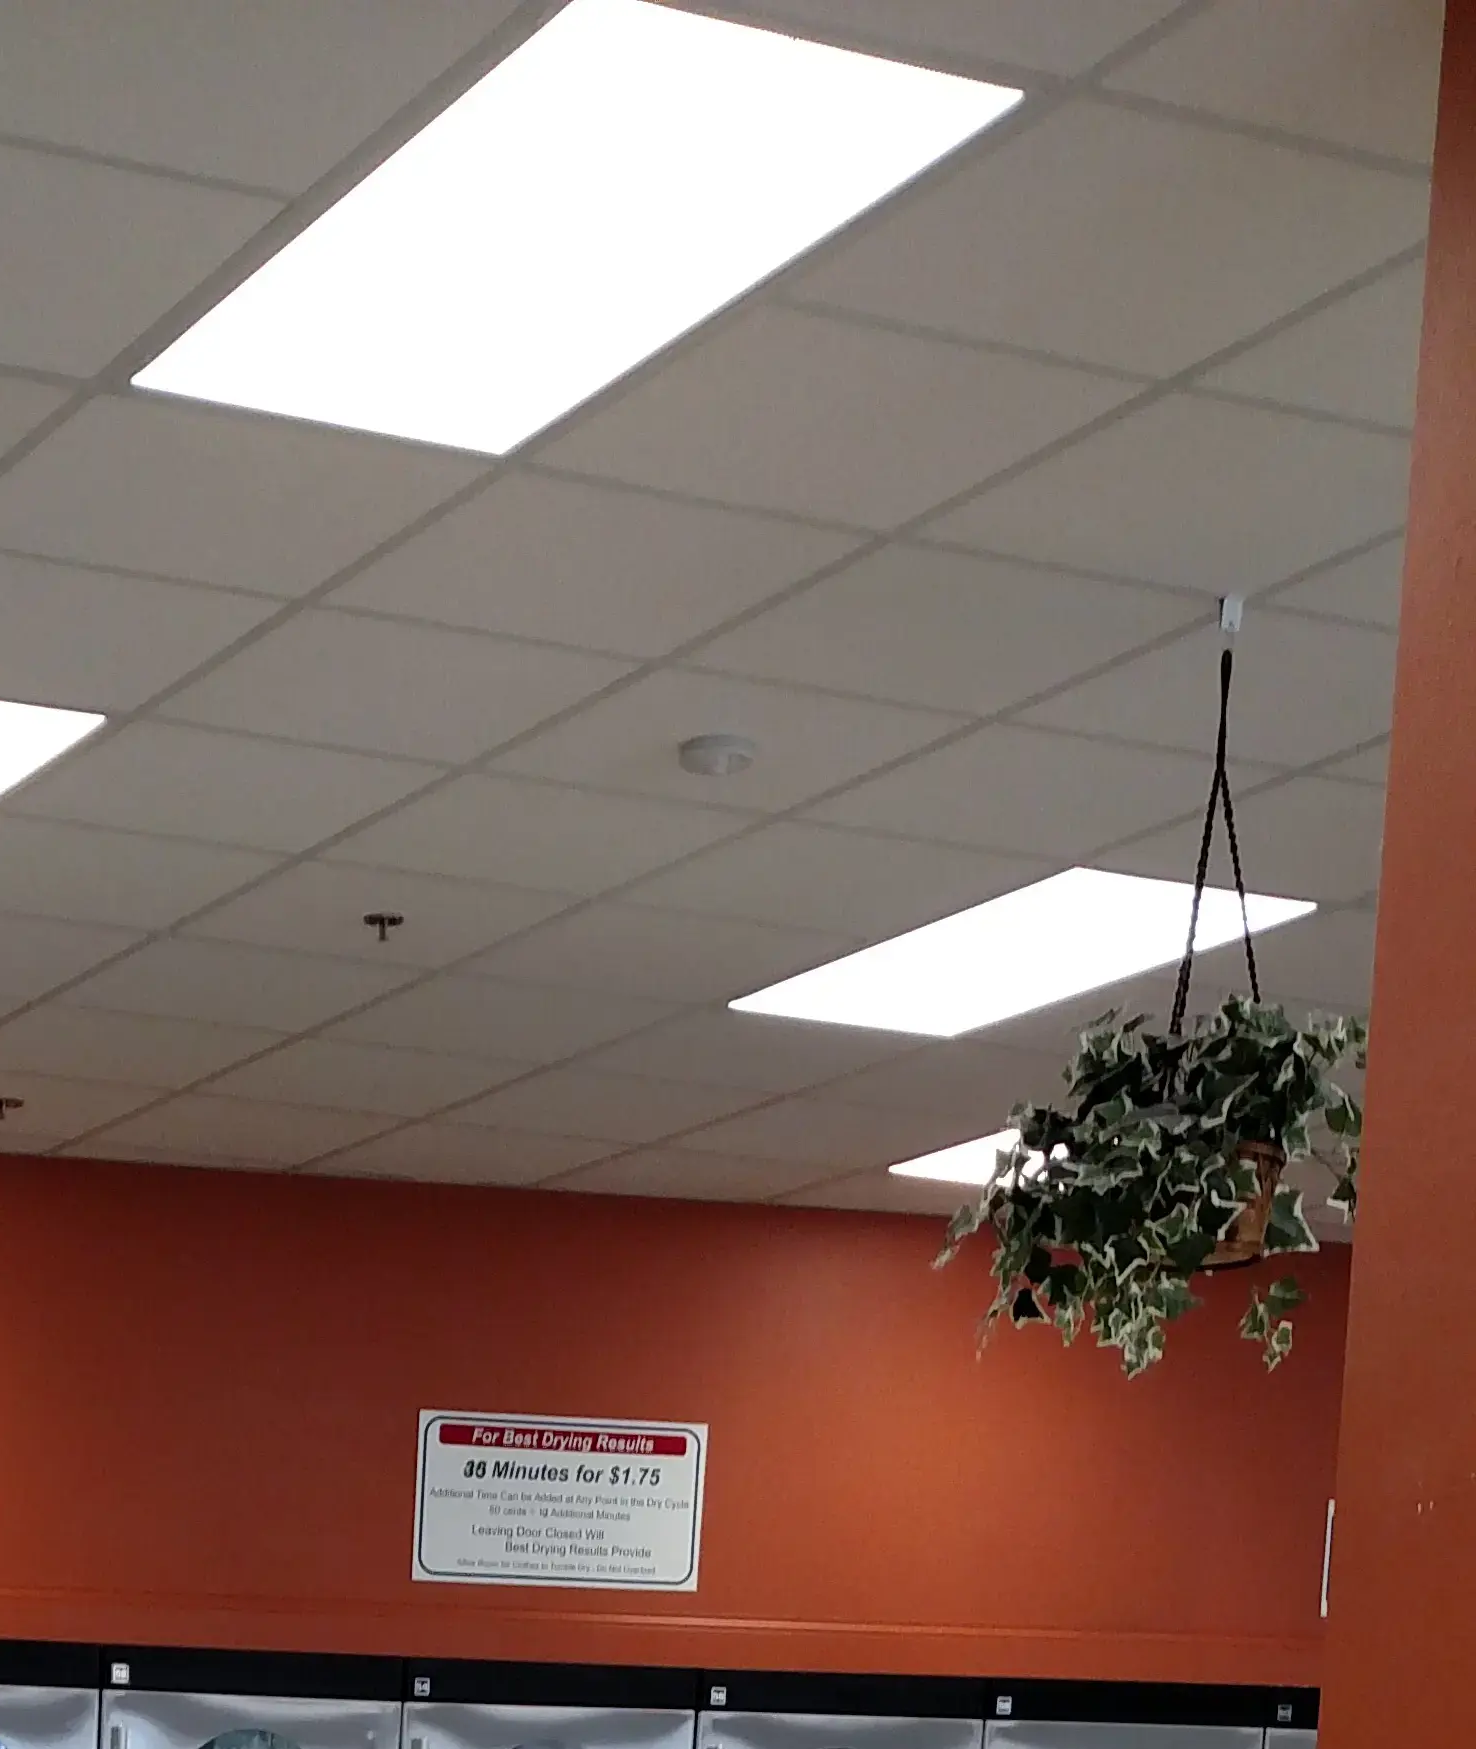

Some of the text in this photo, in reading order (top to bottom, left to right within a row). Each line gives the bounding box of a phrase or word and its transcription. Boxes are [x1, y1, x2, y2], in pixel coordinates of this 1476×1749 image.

[472, 1427, 655, 1454] For Best Drying Results
[492, 1460, 569, 1482] Minutes
[575, 1464, 604, 1484] for
[609, 1465, 661, 1487] $1.75
[472, 1524, 605, 1541] Leaving Door Closed Will
[505, 1540, 652, 1559] Best Drying Results Provide
